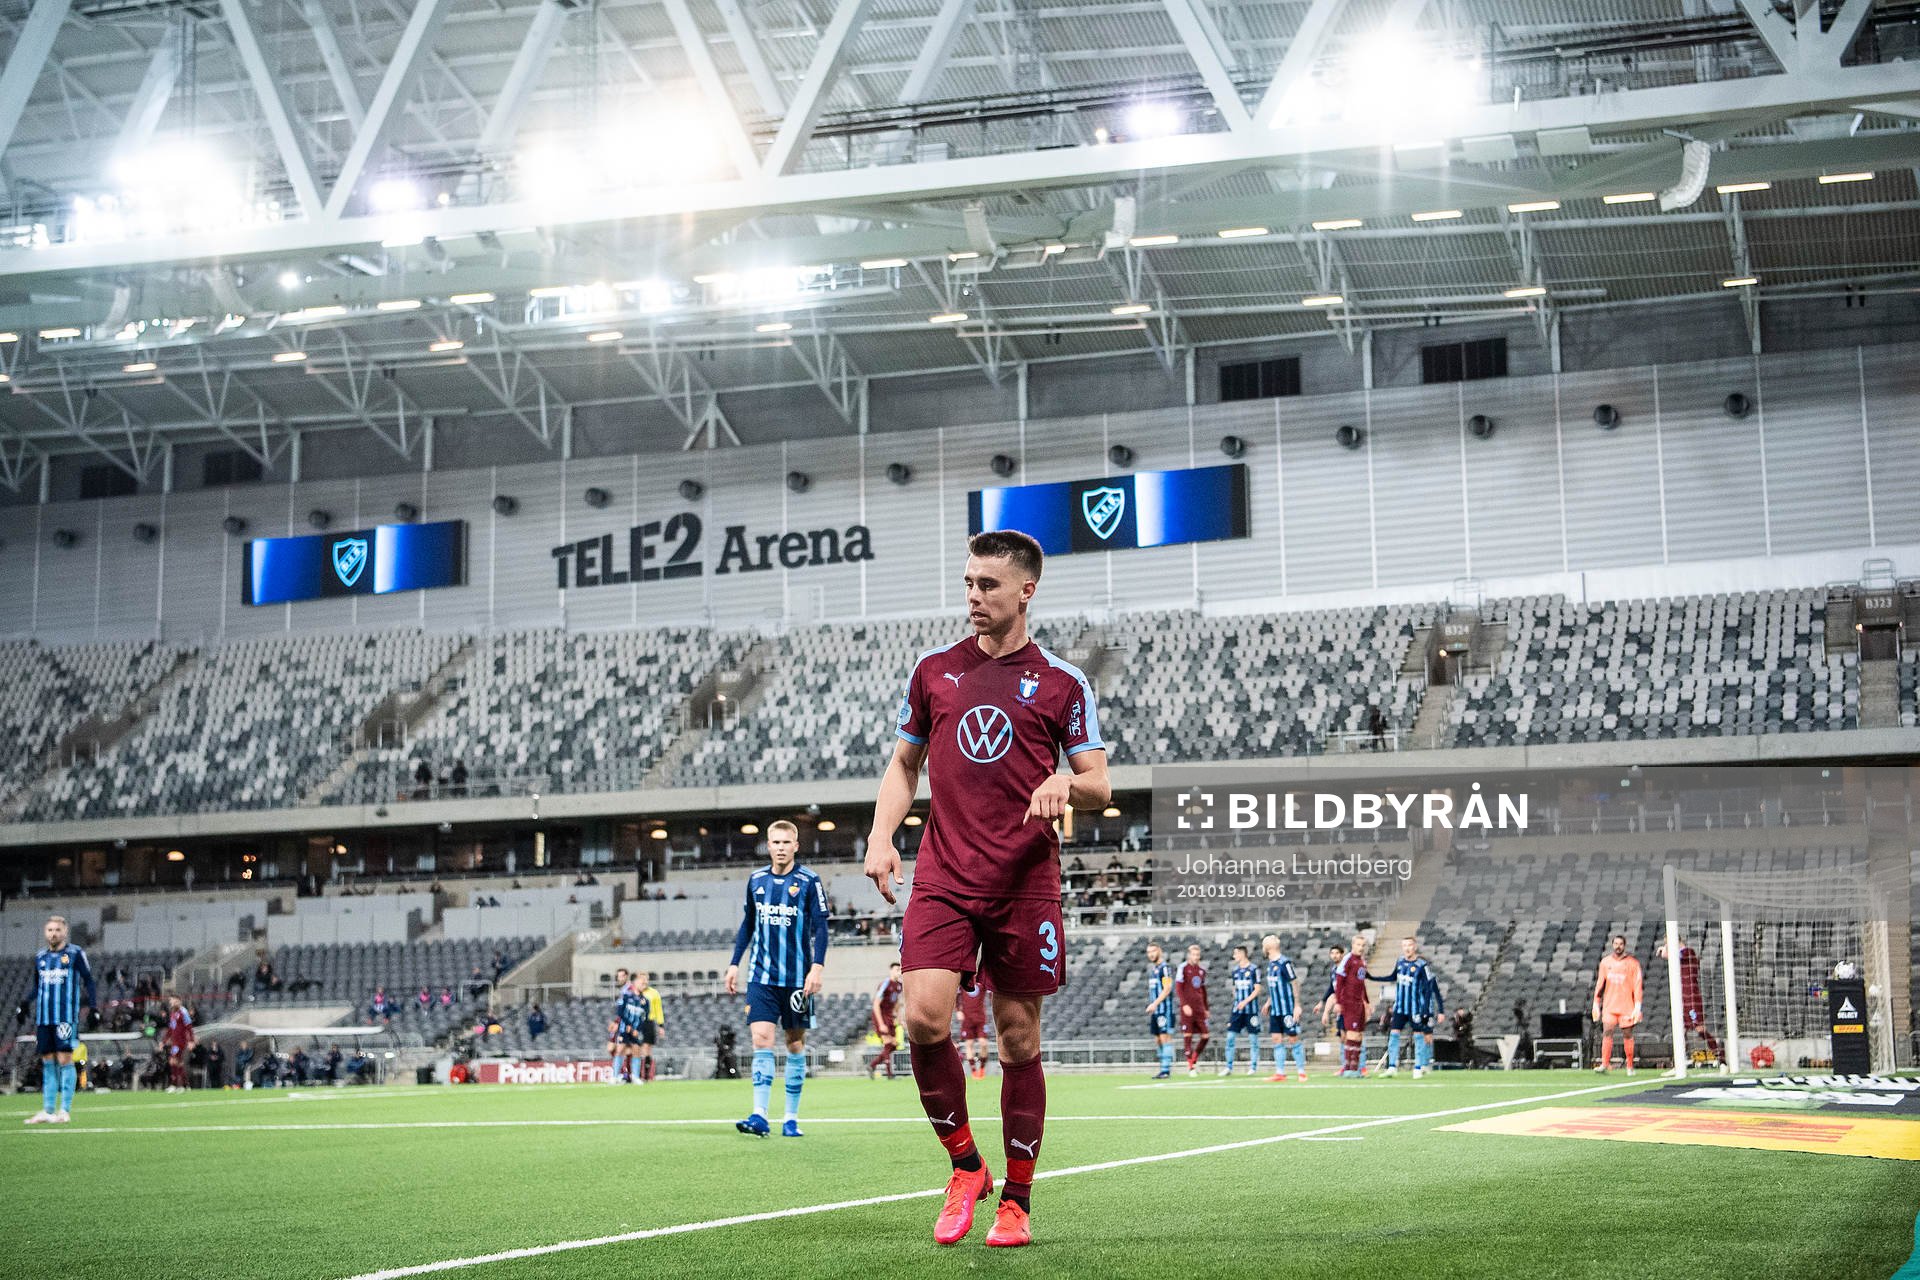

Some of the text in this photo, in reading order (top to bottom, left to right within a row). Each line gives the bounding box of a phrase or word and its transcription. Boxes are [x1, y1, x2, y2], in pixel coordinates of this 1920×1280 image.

[552, 512, 875, 589] TELE2 Arena
[1038, 920, 1059, 961] 3
[498, 1062, 614, 1083] Prioritet Fina
